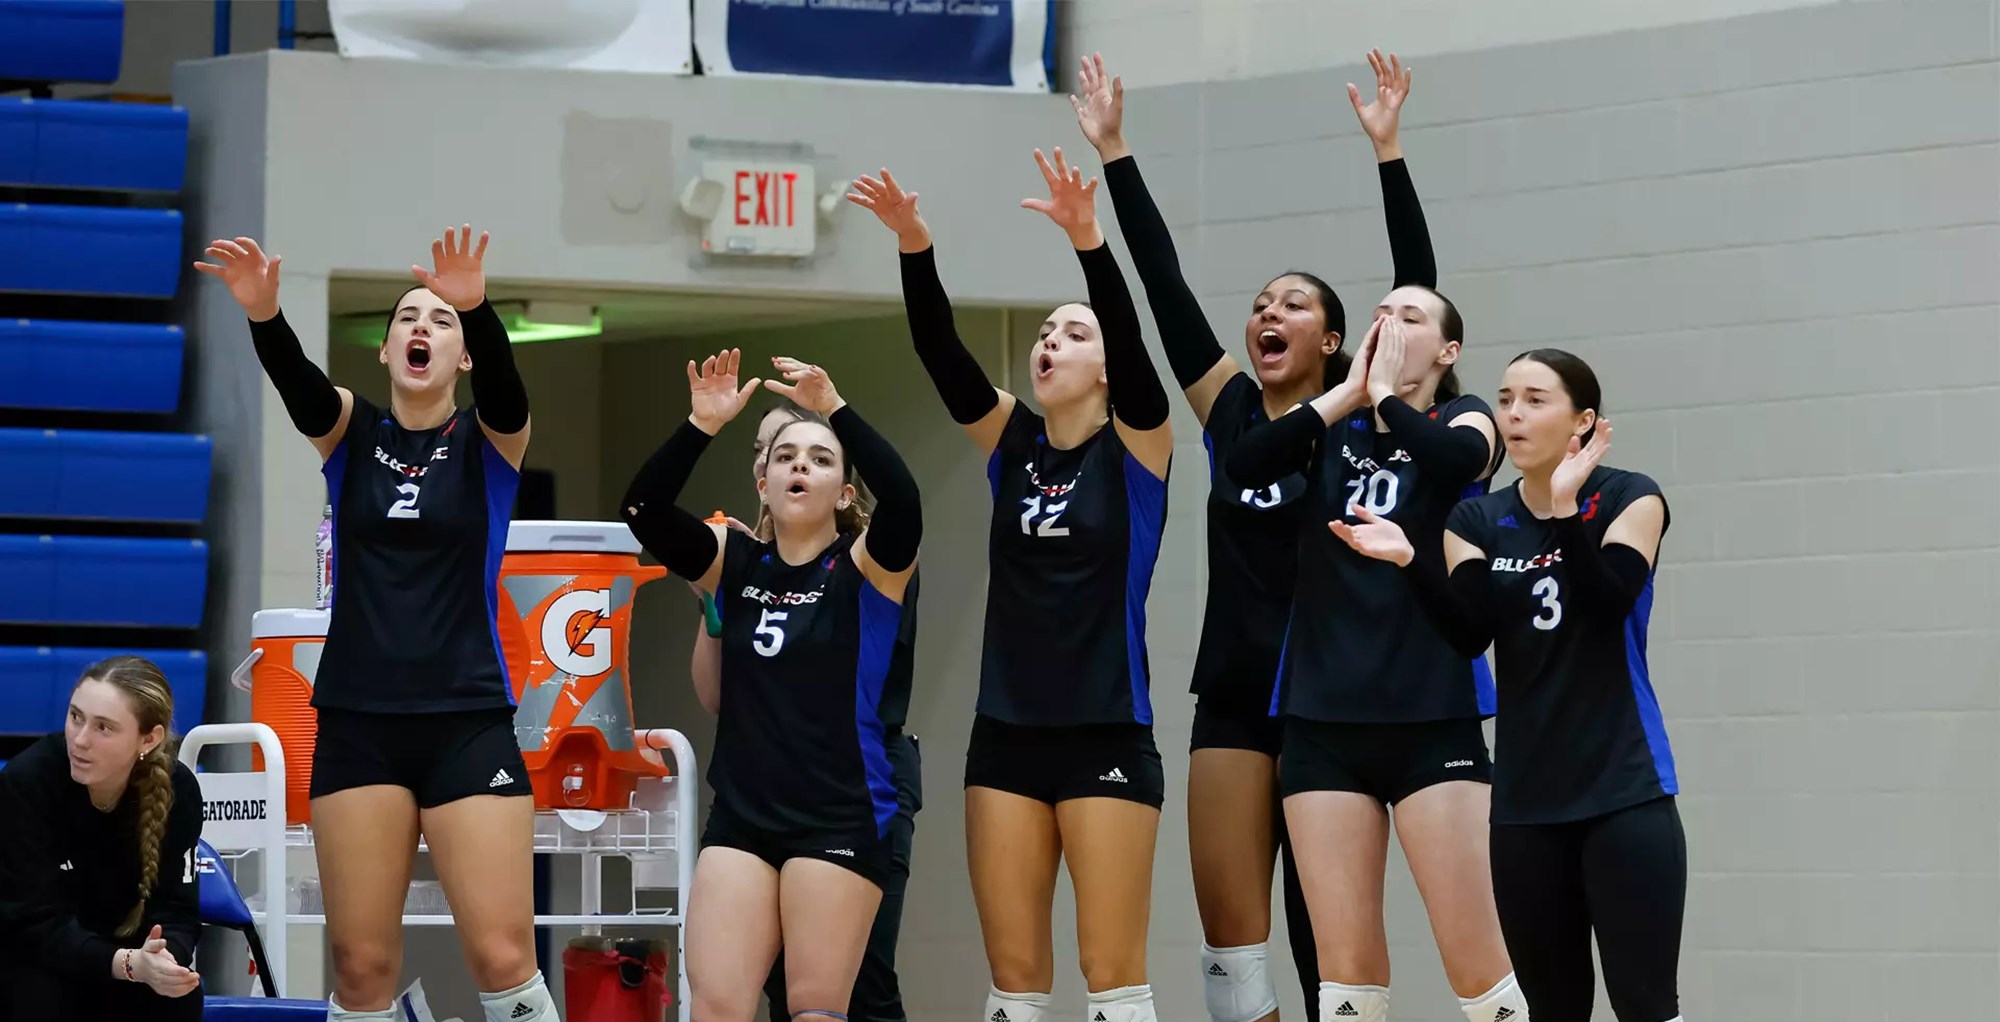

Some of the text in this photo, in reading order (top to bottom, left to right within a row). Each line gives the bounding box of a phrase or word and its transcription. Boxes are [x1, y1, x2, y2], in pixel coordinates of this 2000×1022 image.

[946, 0, 999, 15] Carolina
[734, 170, 798, 228] EXIT
[387, 482, 420, 518] 2
[1532, 576, 1562, 630] 3
[540, 588, 613, 678] G
[752, 608, 789, 657] 5
[1444, 759, 1474, 768] adidas
[489, 777, 515, 788] adidas
[202, 799, 267, 822] GATORADE
